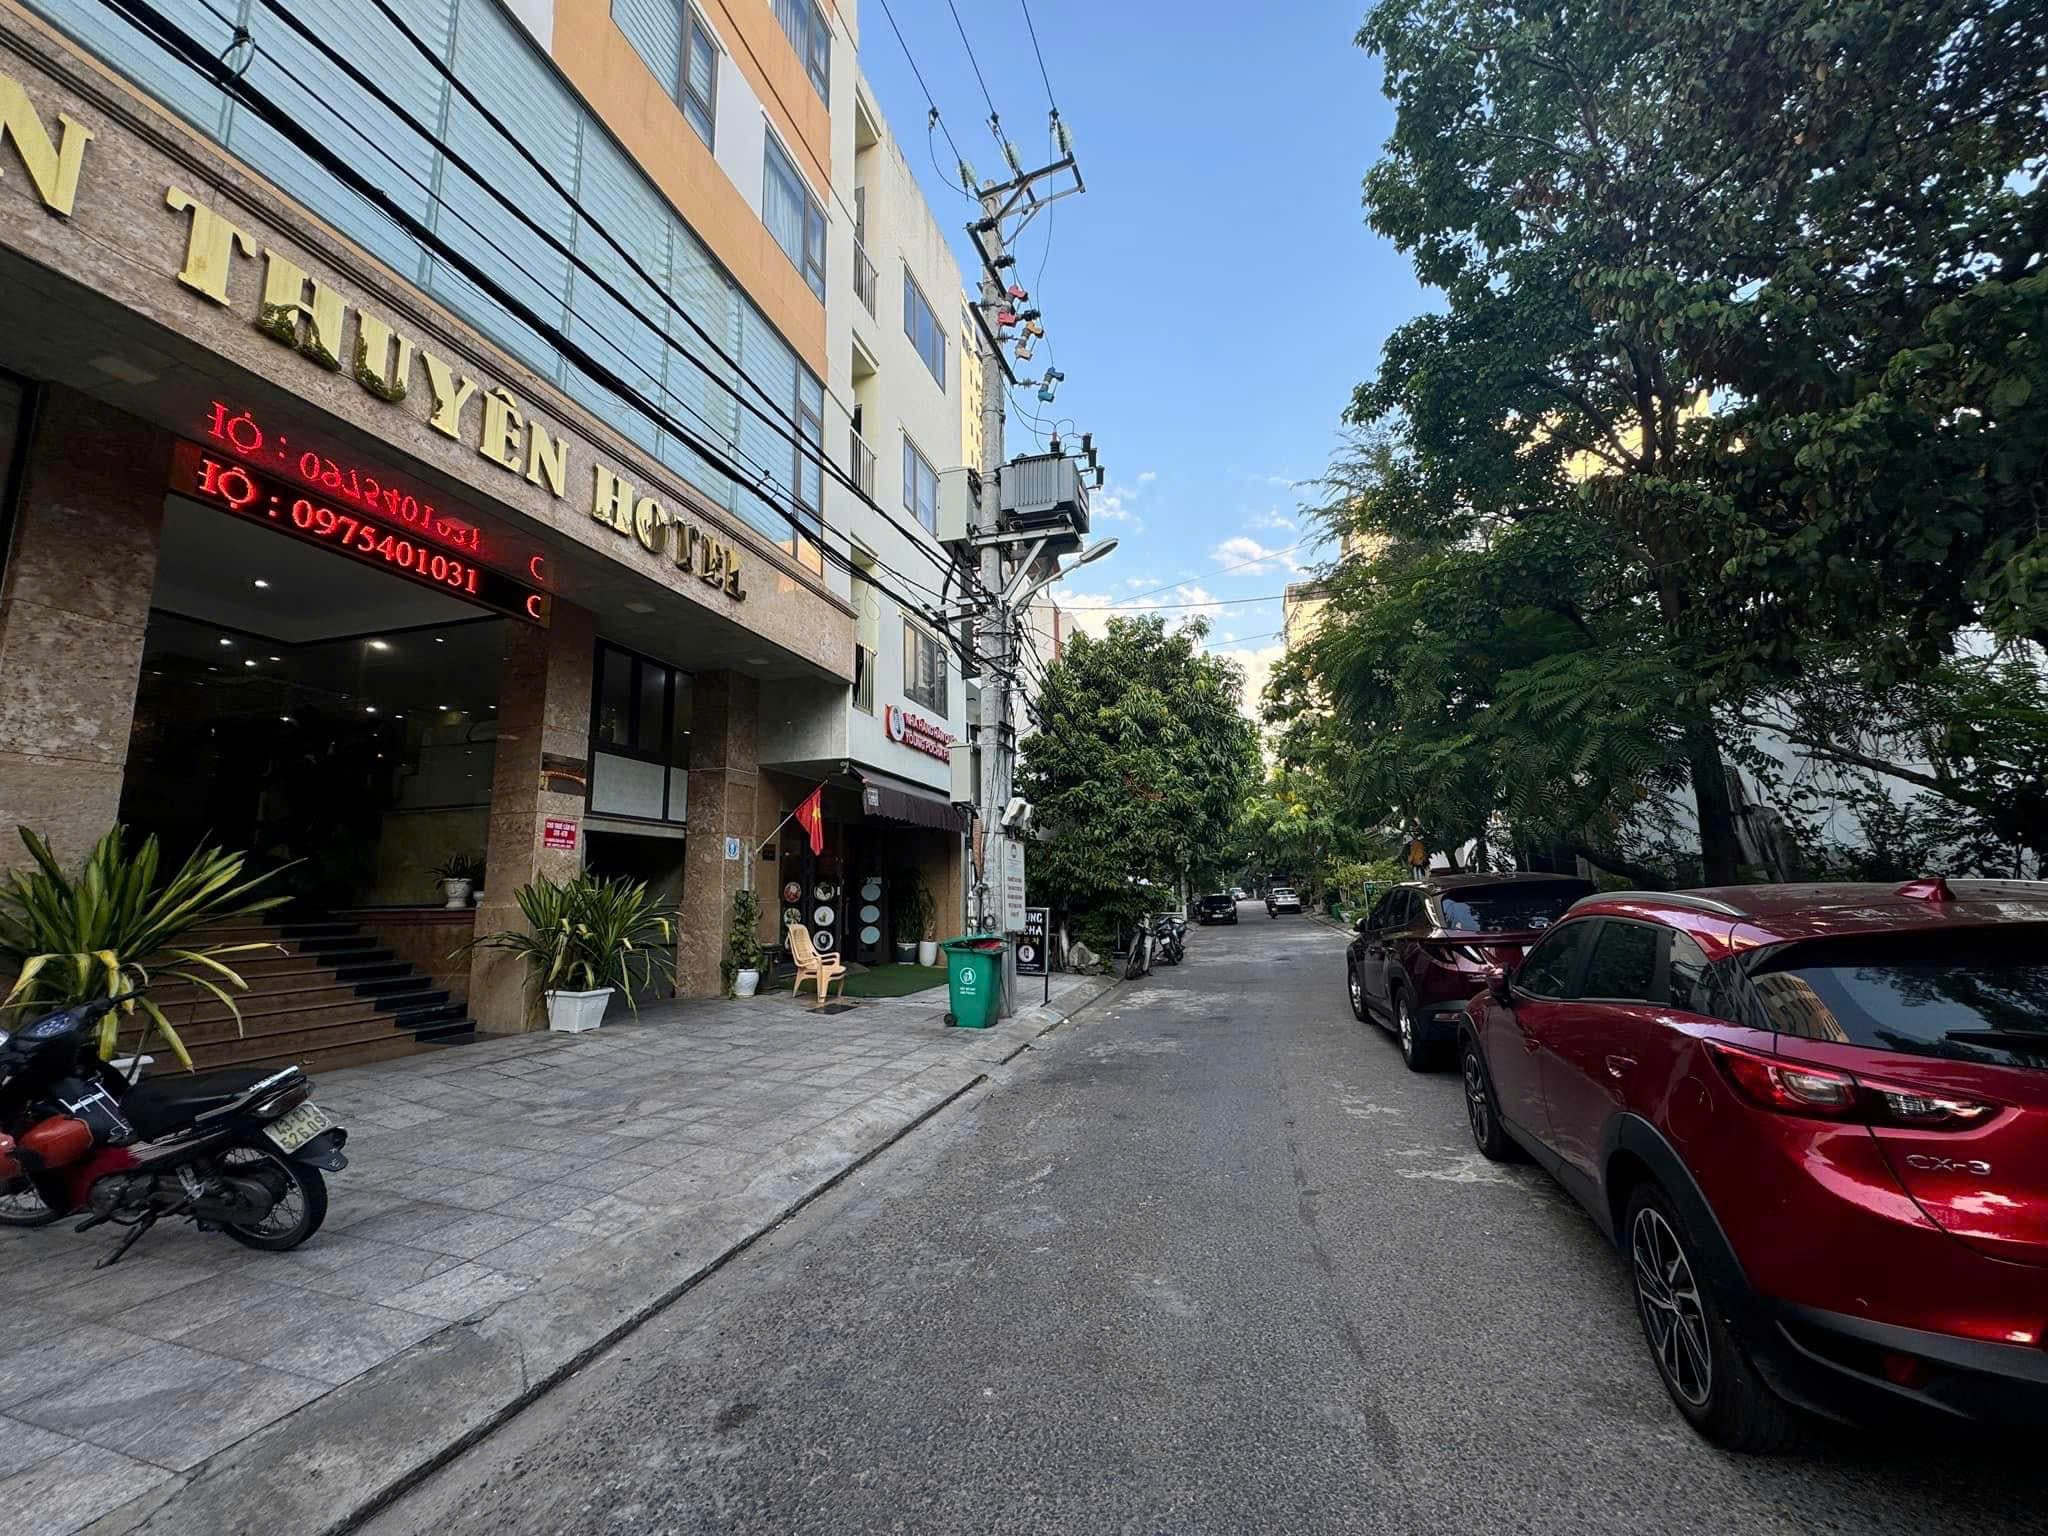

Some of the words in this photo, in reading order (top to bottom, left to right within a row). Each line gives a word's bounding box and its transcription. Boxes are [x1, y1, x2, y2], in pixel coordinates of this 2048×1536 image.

[165, 184, 570, 499] THUYÊN
[591, 463, 747, 602] HOTEL
[292, 498, 477, 595] 0975401031
[1905, 1154, 1992, 1176] CX-3
